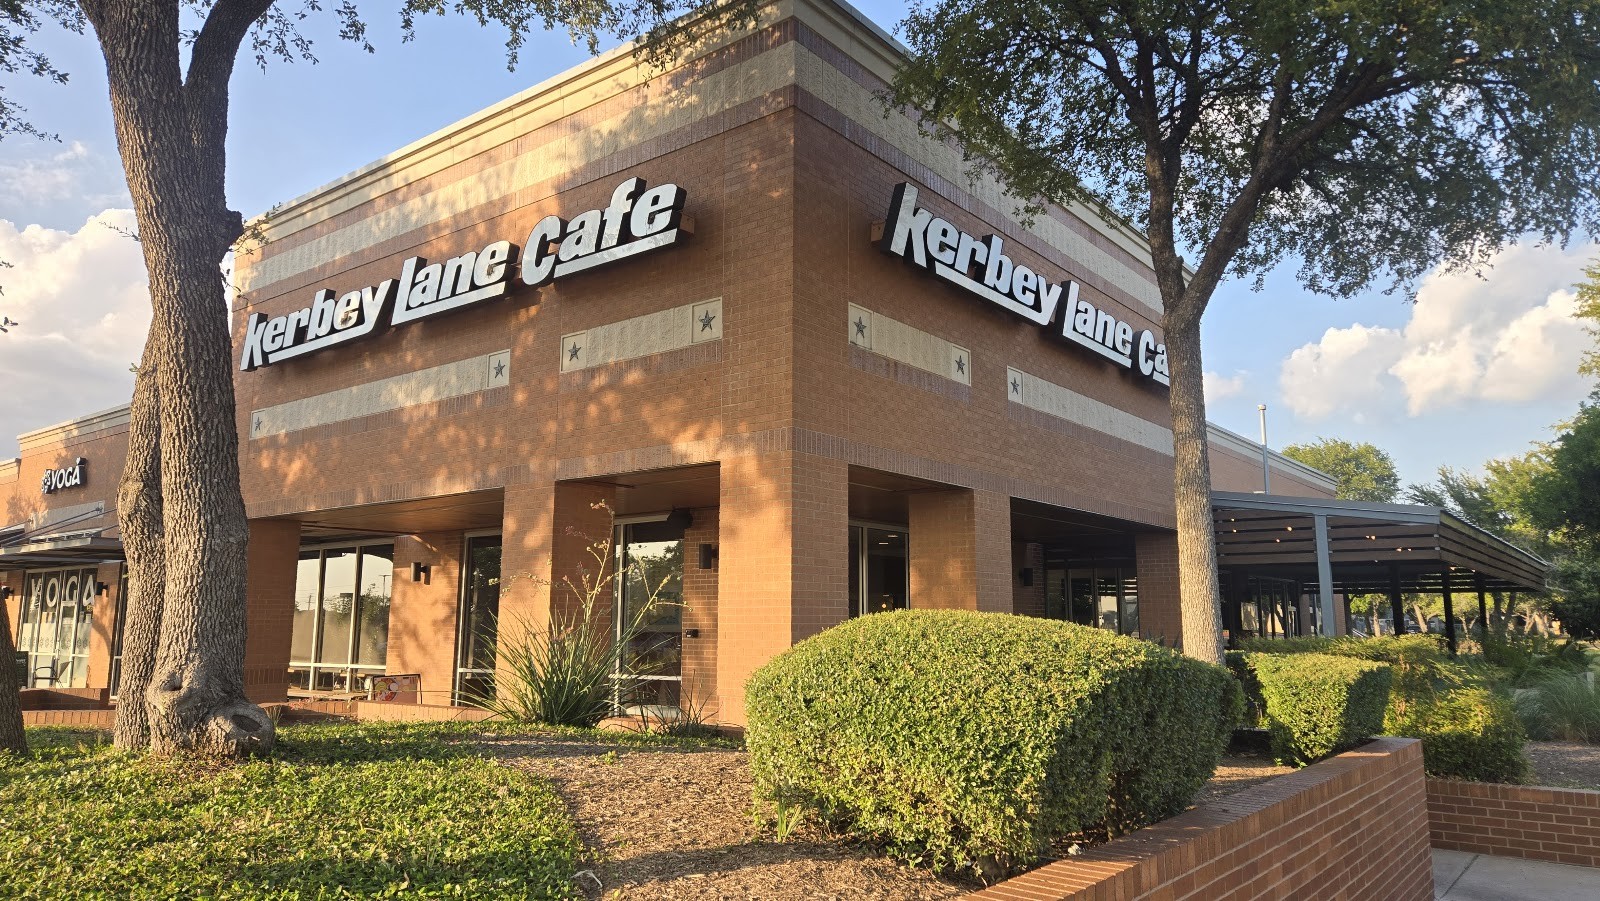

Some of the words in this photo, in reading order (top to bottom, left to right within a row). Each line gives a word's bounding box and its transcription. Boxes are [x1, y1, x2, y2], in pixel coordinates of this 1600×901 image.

[522, 177, 678, 285] Cafe
[1139, 330, 1169, 386] Ca
[51, 465, 80, 489] YOGA
[30, 575, 95, 609] YOGA
